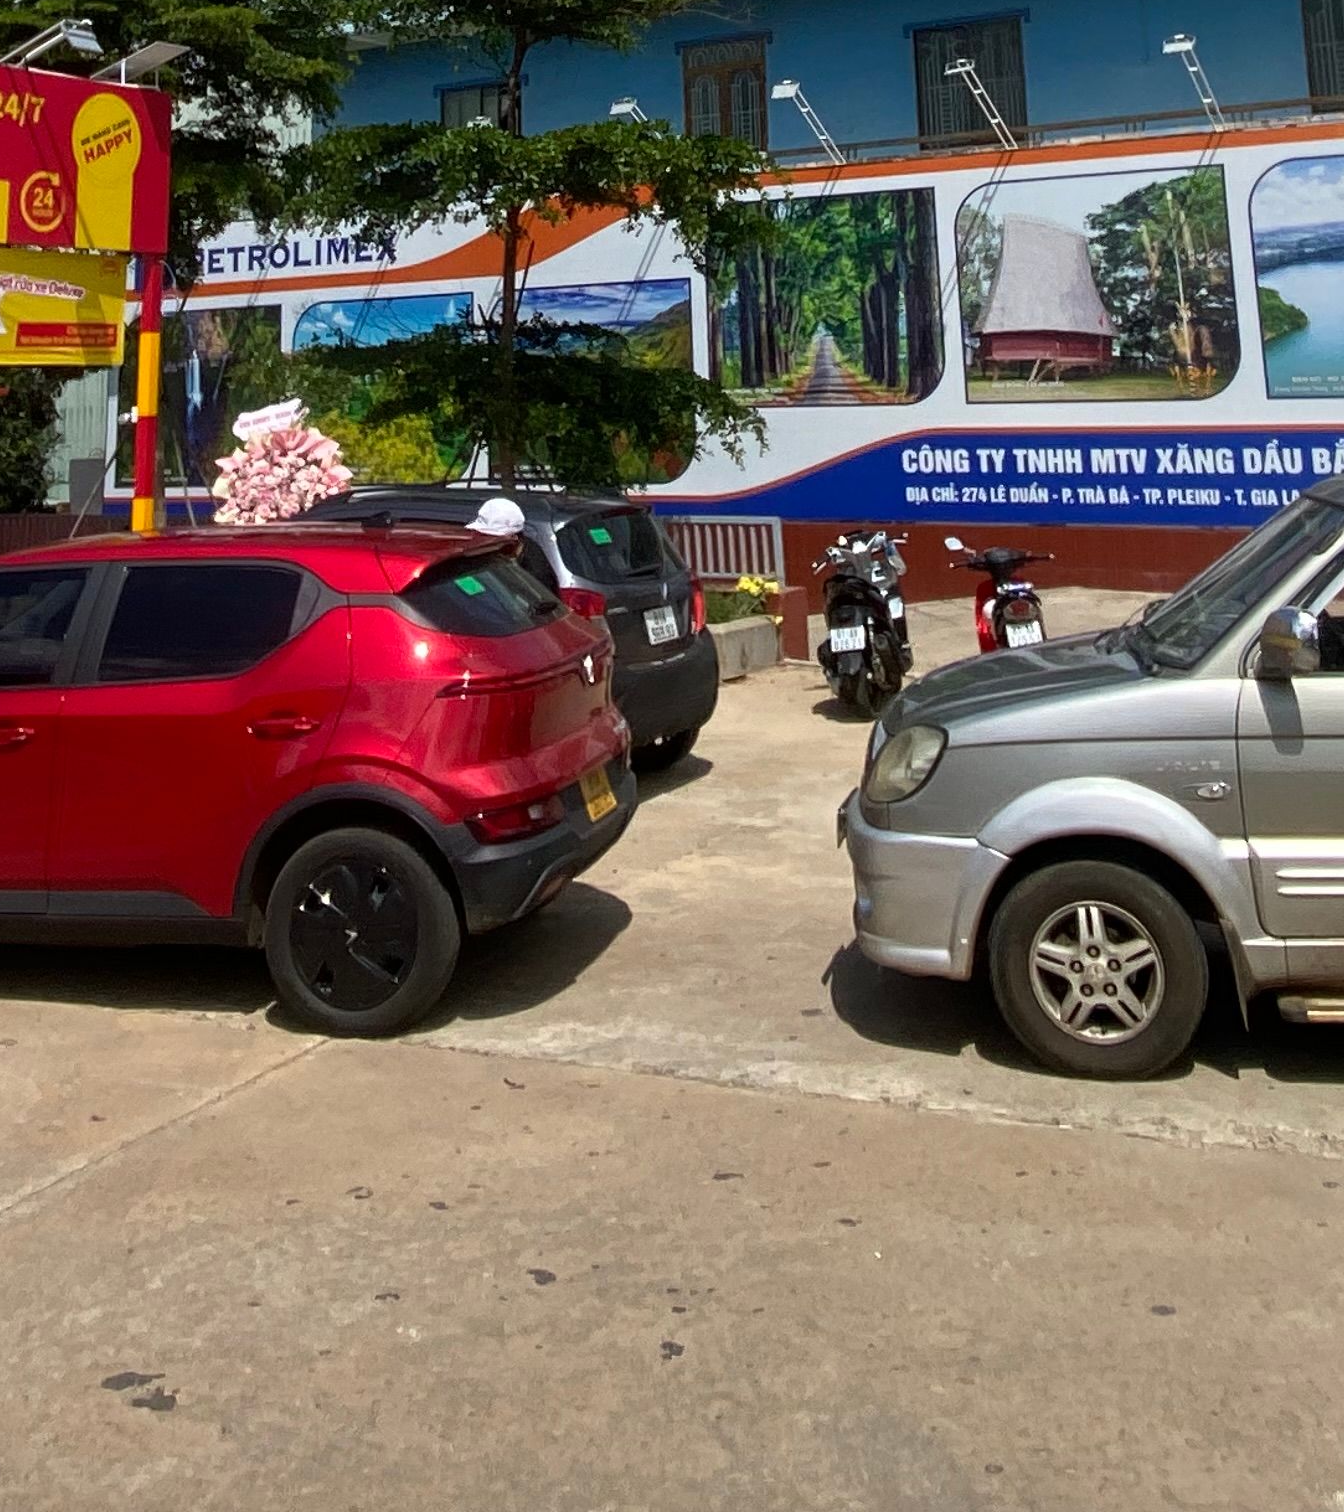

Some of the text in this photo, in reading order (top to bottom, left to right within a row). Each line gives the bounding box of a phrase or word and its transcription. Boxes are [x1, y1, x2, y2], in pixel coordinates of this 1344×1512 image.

[83, 128, 133, 164] HAPPY
[32, 186, 55, 209] 24
[902, 444, 970, 474] CÔNG
[976, 448, 1005, 474] TY
[1013, 448, 1084, 474] TNHH
[1090, 448, 1147, 474] MTV
[1156, 442, 1235, 475] XĂNG
[1243, 438, 1303, 475] DẦU
[906, 487, 929, 505] ĐỊA
[961, 487, 987, 503] 274
[990, 484, 1007, 503] LÊ
[1061, 488, 1074, 504] P.
[1077, 484, 1107, 504] TRÀ
[1143, 488, 1164, 505] TP.
[1167, 488, 1221, 506] PLEIKU
[1234, 488, 1247, 506] T.
[1251, 488, 1279, 506] GIA
[1282, 488, 1301, 506] LA
